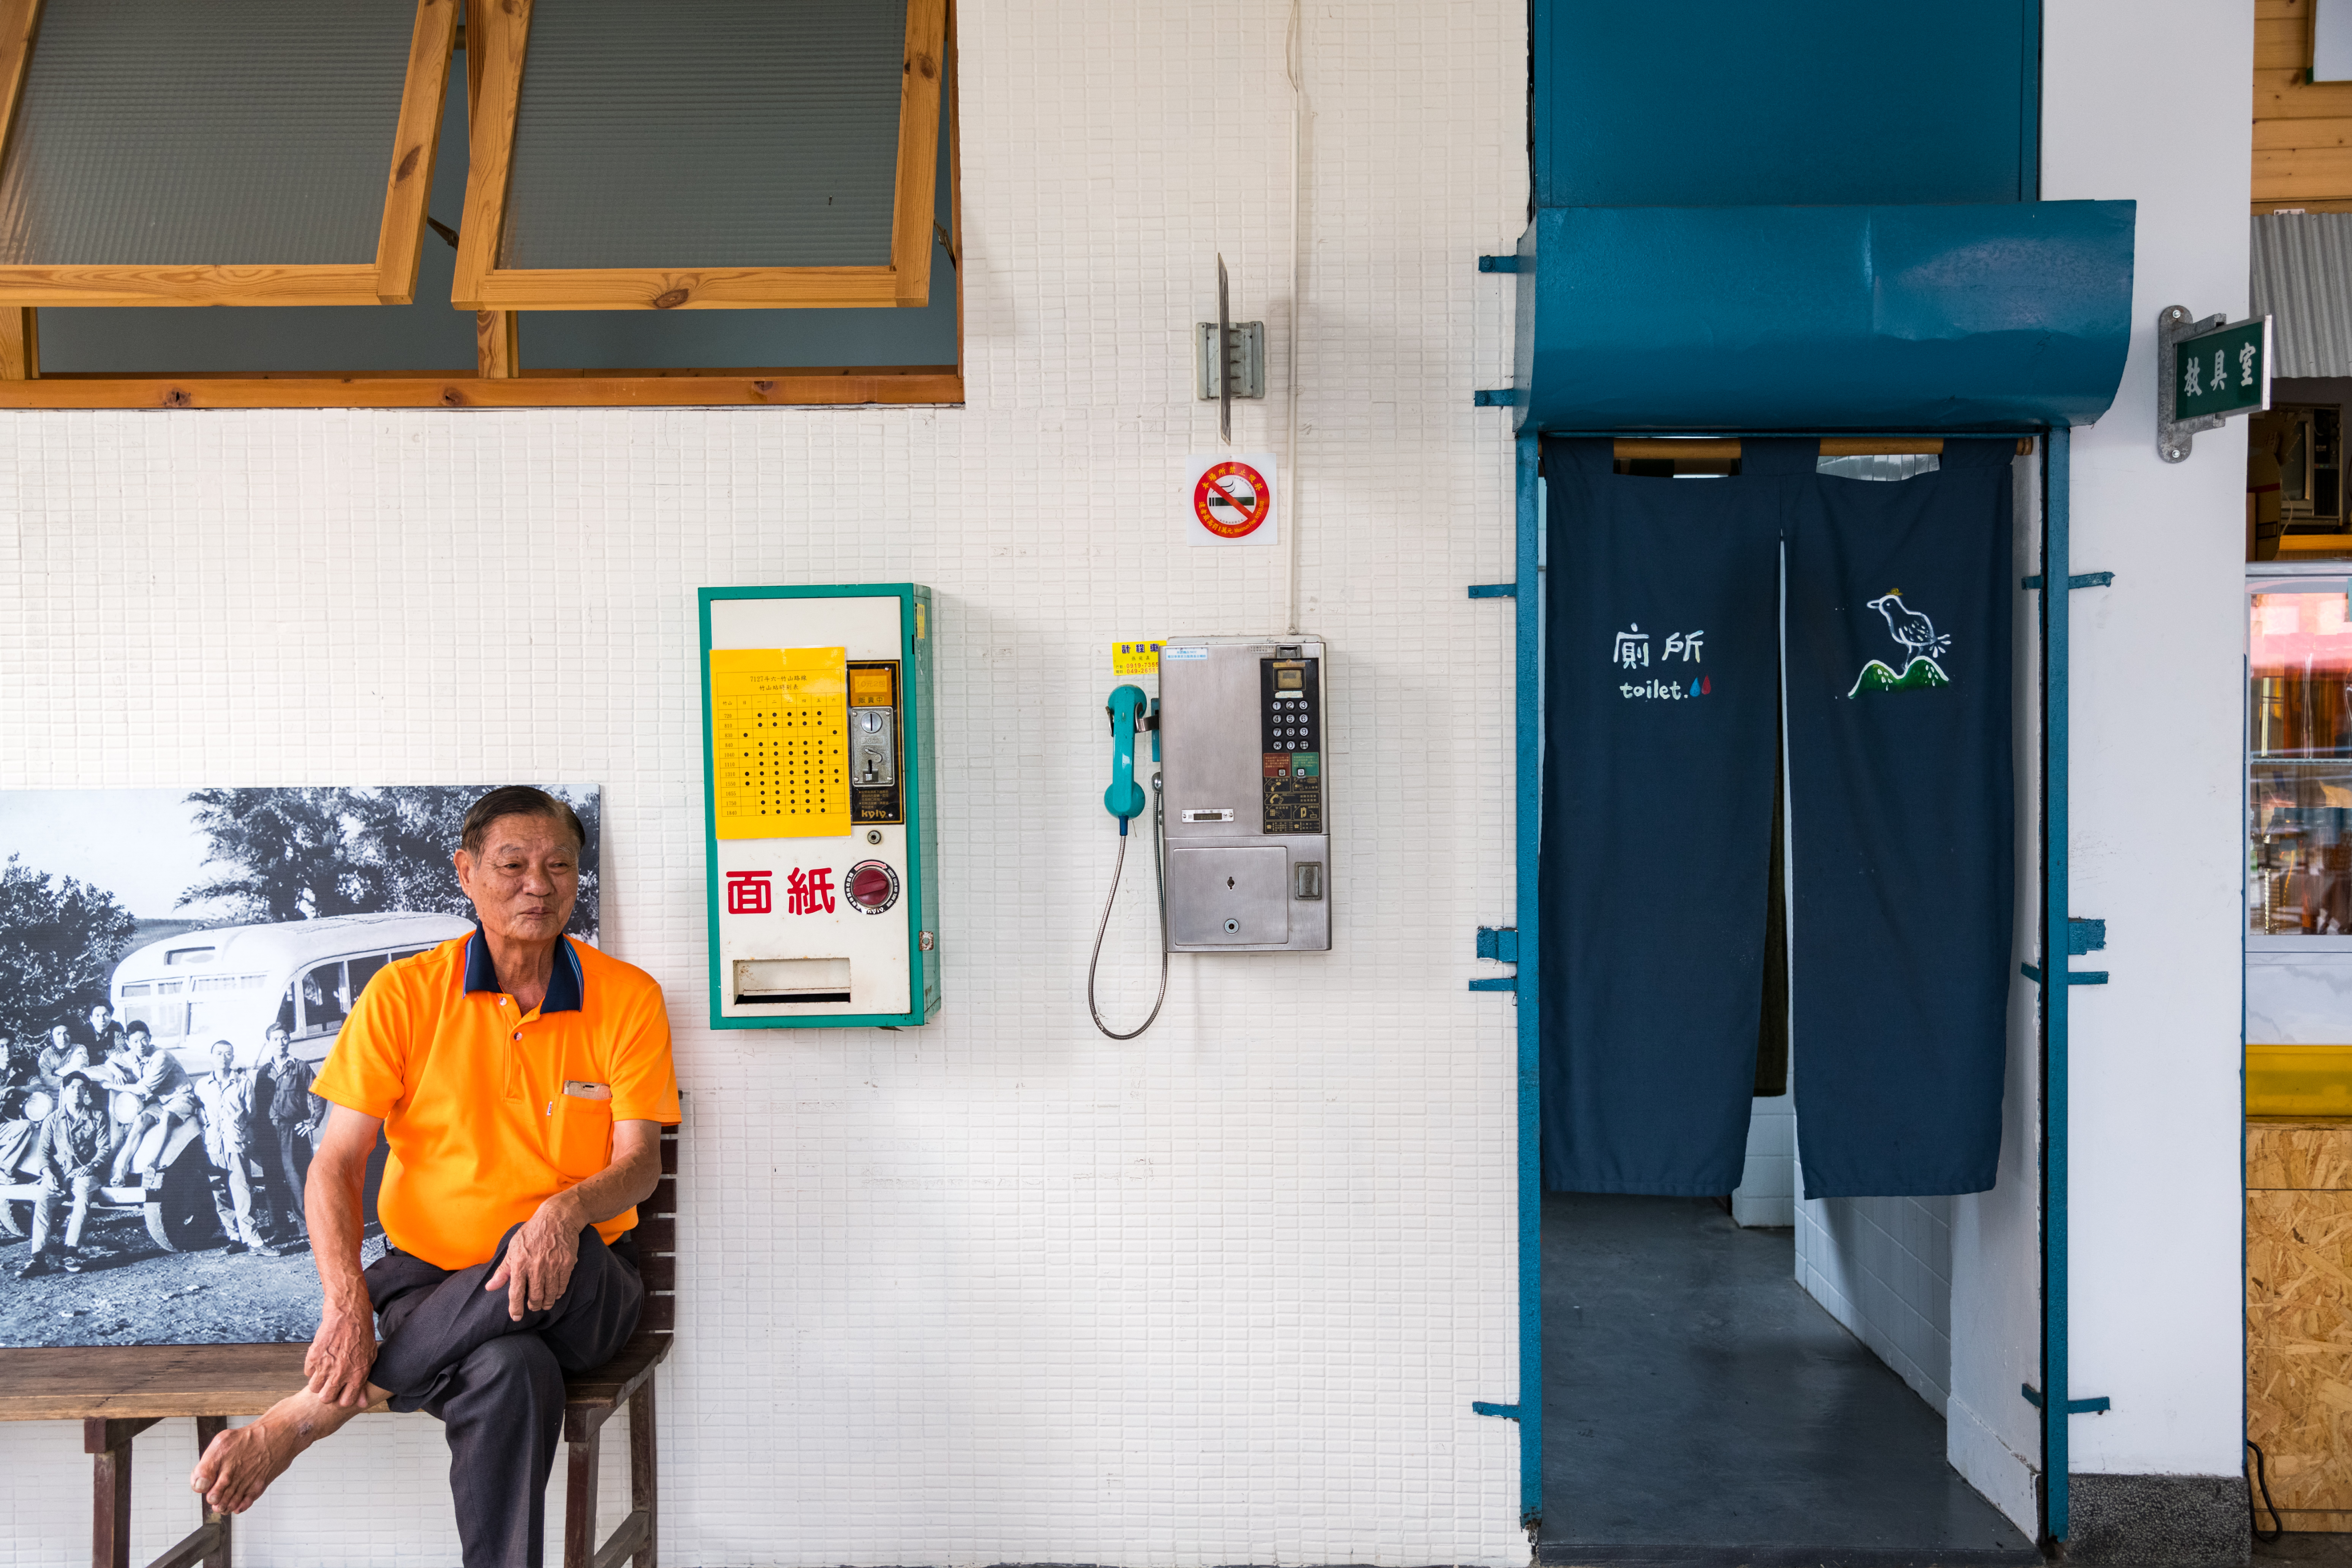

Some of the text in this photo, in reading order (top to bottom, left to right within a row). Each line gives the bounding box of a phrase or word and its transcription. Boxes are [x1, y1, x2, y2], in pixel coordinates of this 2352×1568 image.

[1202, 466, 1263, 491] 本場所禁止吸菸
[1234, 524, 1250, 533] Maximum
[1122, 644, 1158, 653] 計程車
[1613, 623, 1704, 669] 廁所
[1620, 679, 1688, 700] toilet.
[861, 809, 886, 819] kyly
[726, 867, 835, 915] 面紙
